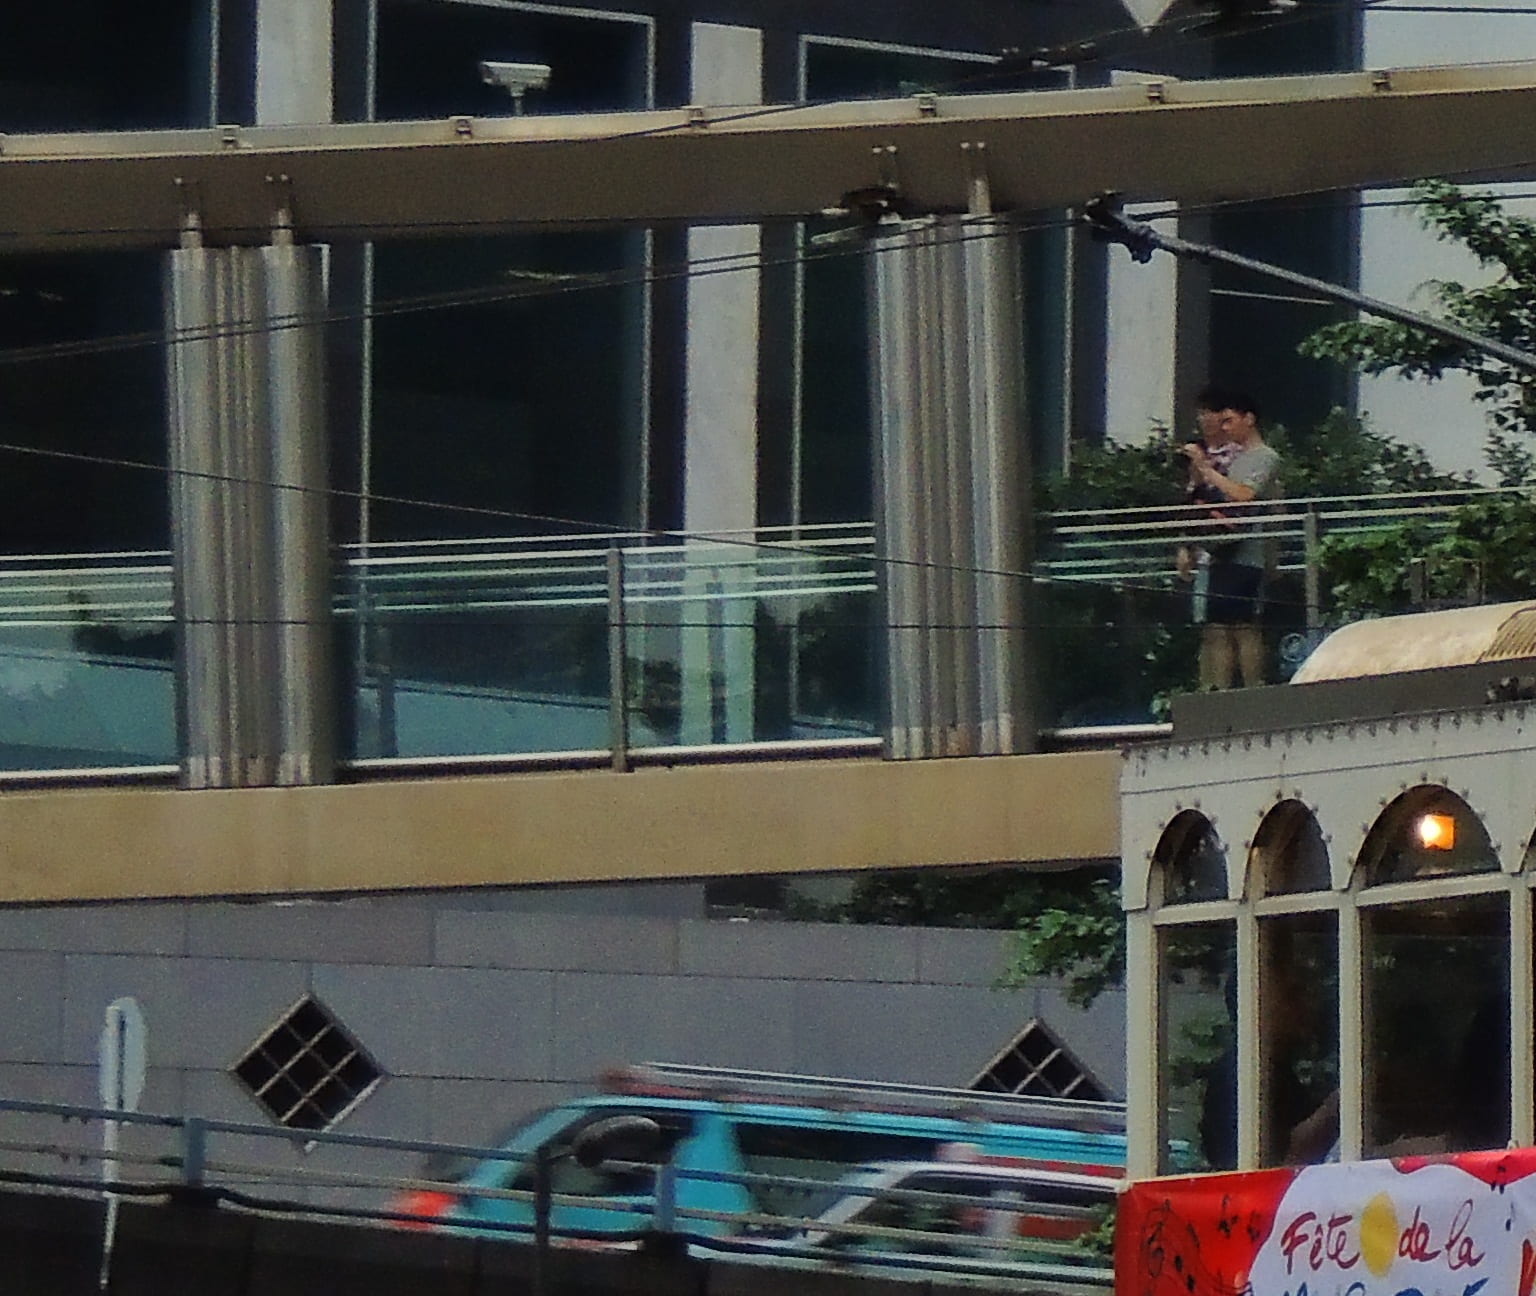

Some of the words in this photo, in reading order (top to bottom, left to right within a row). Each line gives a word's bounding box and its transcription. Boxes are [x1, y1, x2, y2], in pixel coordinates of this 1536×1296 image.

[1280, 1210, 1360, 1276] Fête
[1398, 1205, 1443, 1264] de
[1444, 1199, 1485, 1269] la
